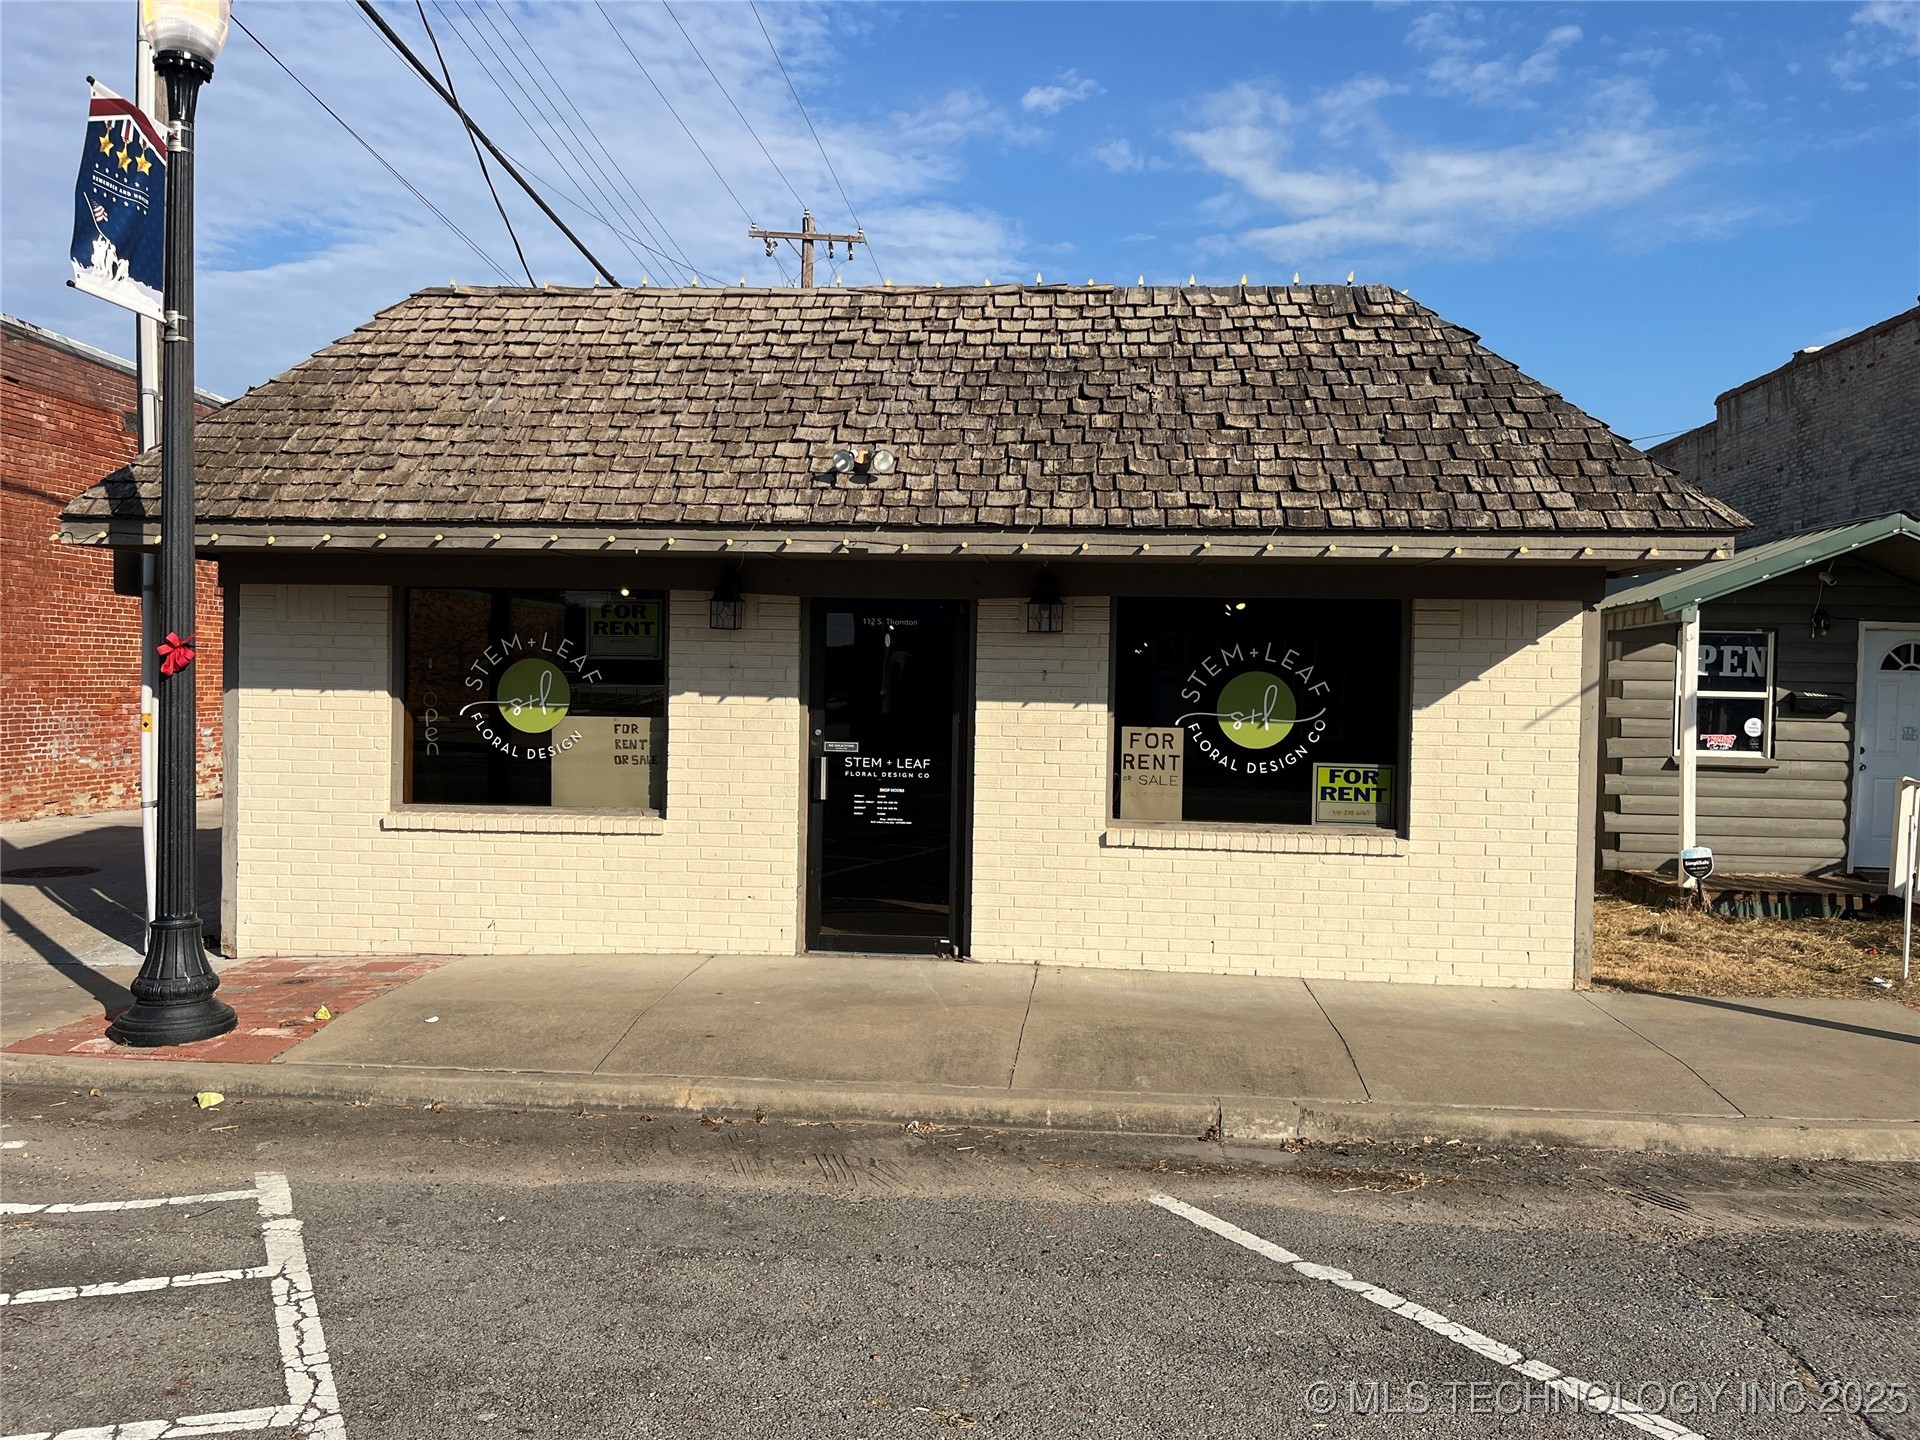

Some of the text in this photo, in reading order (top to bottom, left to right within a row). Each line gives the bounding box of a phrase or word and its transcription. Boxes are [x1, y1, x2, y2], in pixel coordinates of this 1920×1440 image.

[118, 188, 132, 197] AND
[601, 604, 647, 619] FOR
[593, 621, 655, 636] RENT
[886, 618, 918, 626] Thornton
[1698, 645, 1767, 677] PEN
[470, 712, 584, 760] FLORAL DESIGN
[614, 723, 639, 734] FOR
[614, 739, 648, 750] RENT
[1129, 732, 1174, 749] FOR
[1188, 719, 1326, 774] FLORAL DESIGN CO
[614, 754, 658, 765] OR SALE
[845, 757, 882, 768] STEM
[897, 758, 931, 769] LEAF
[1123, 753, 1180, 771] RENT
[1139, 774, 1178, 787] SALE
[1329, 769, 1379, 785] FOR
[1321, 786, 1387, 803] RENT
